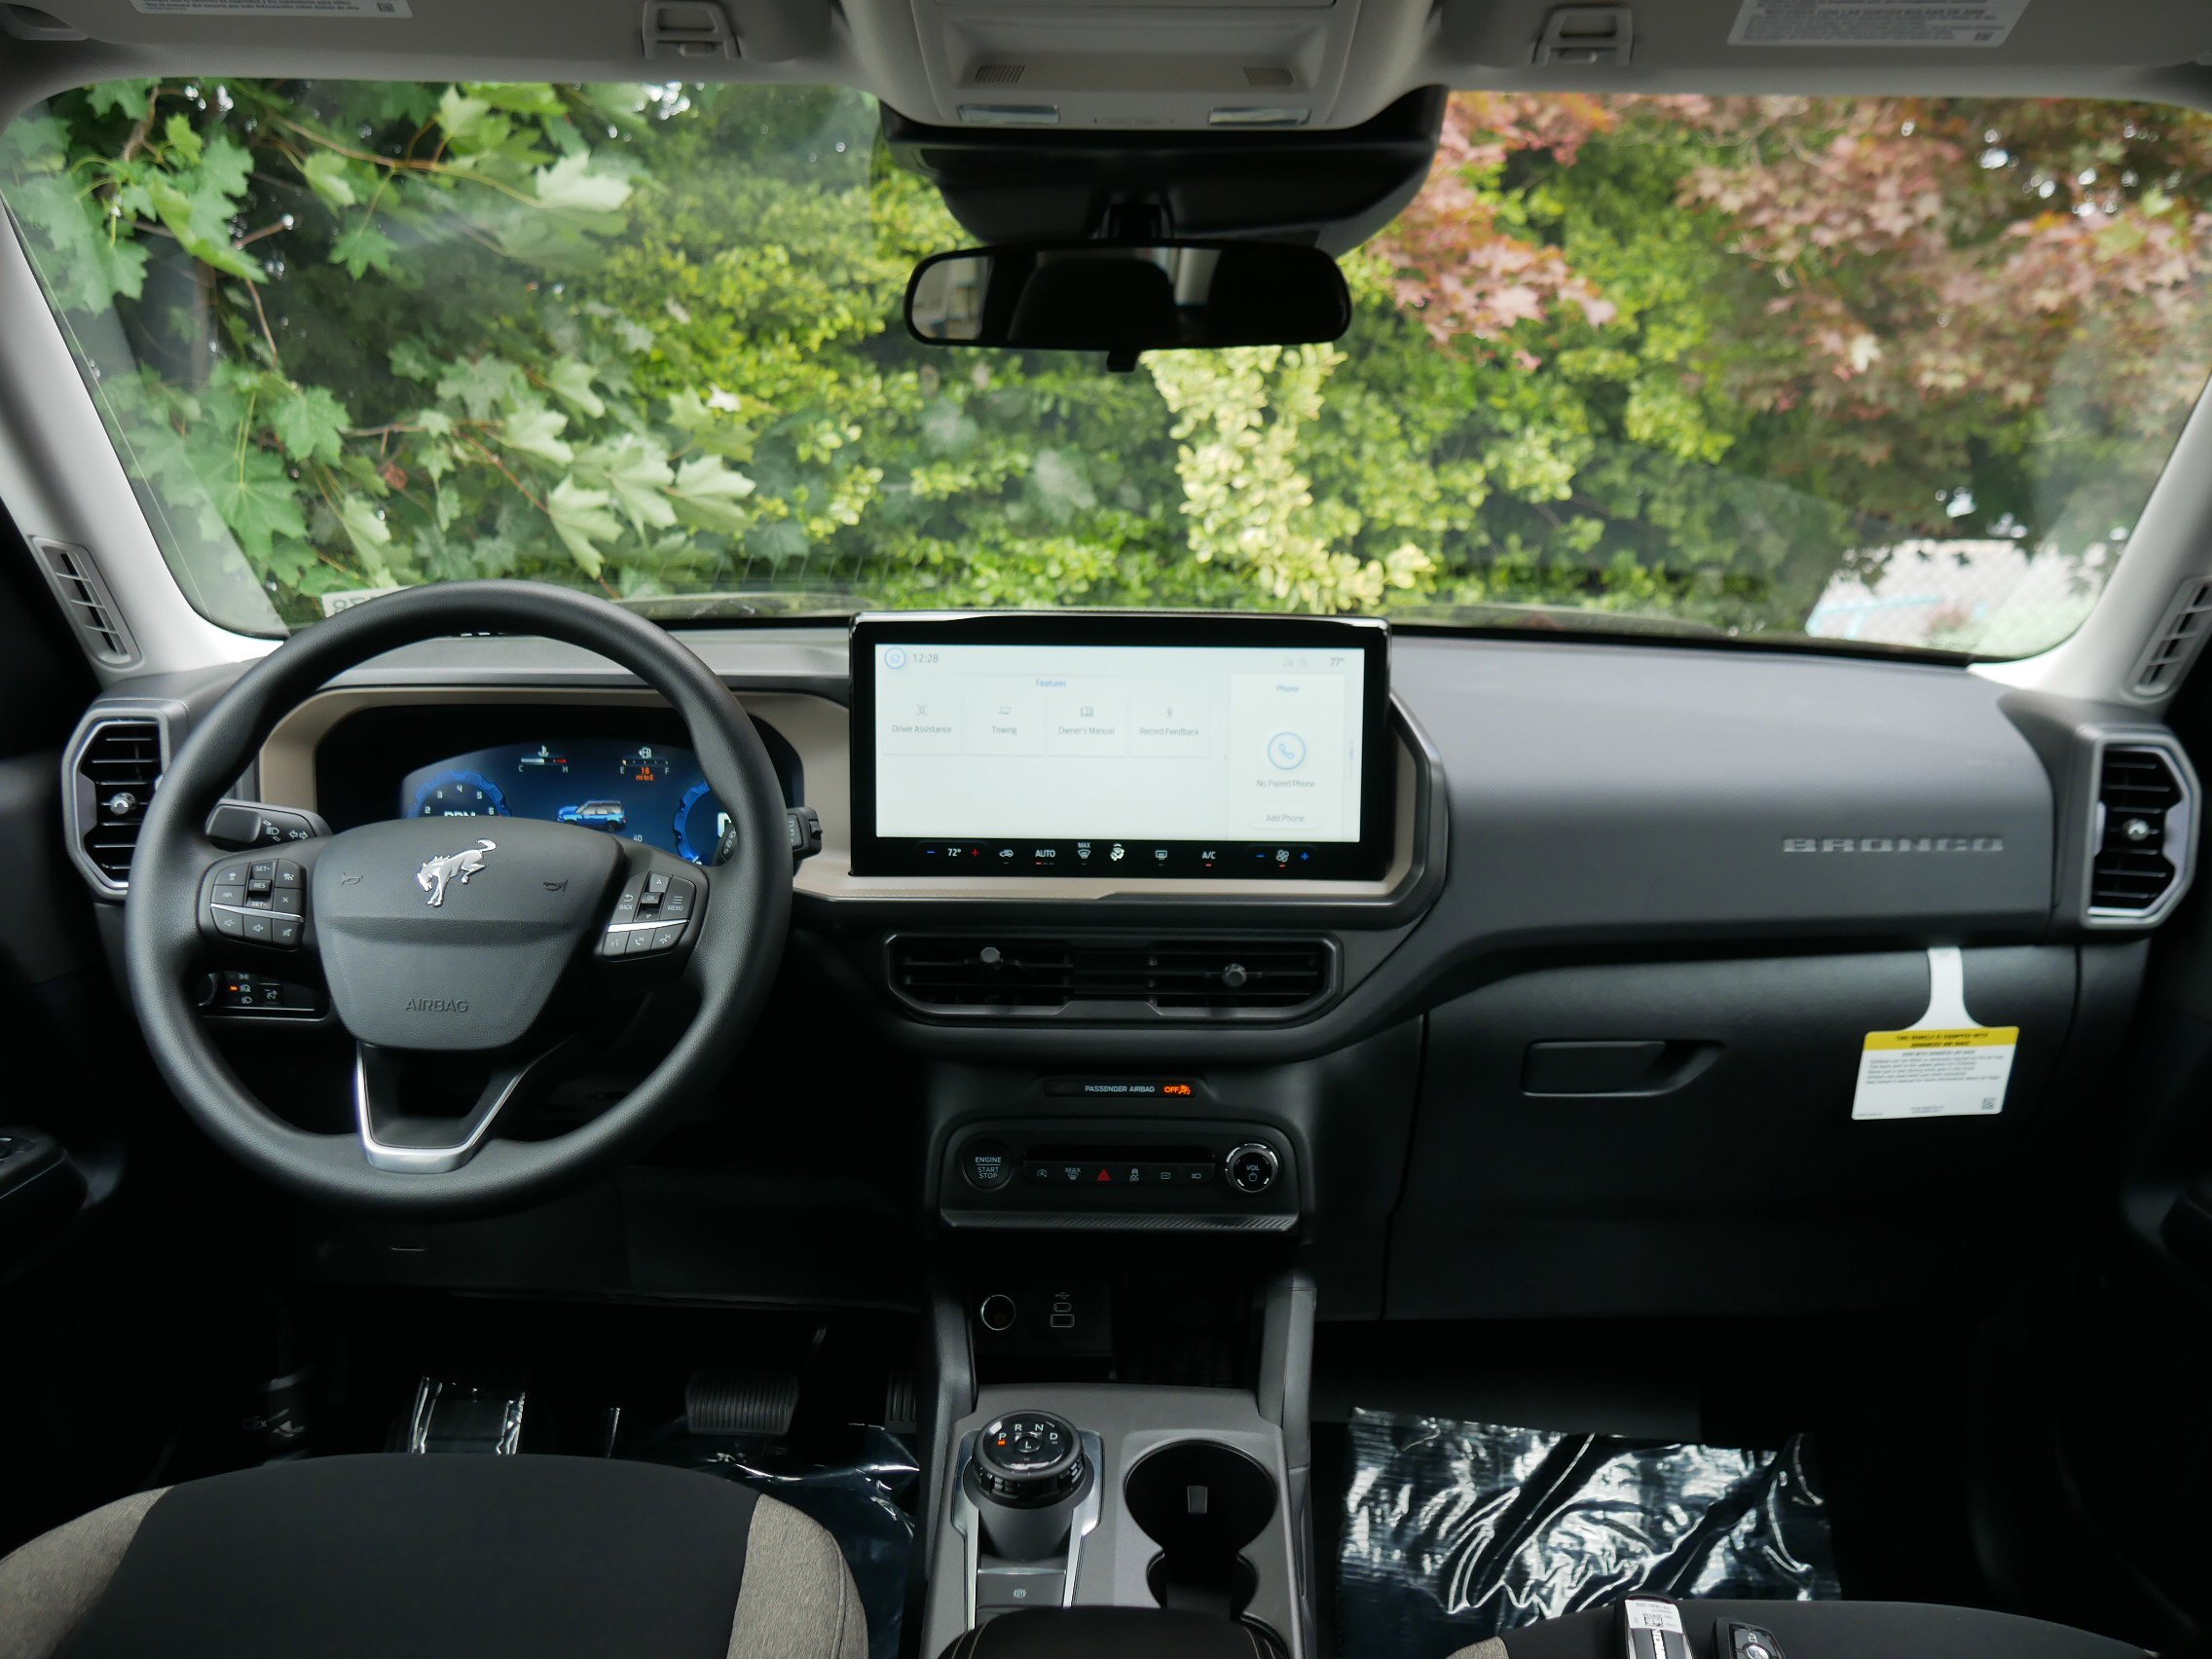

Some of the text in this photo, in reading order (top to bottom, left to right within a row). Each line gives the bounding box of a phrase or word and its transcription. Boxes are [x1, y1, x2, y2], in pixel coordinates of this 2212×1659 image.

[913, 653, 939, 663] 12:28
[1036, 679, 1067, 687] Features
[1275, 683, 1300, 693] Phone
[892, 724, 952, 733] Driver Assistance
[991, 725, 1018, 736] Towing
[1057, 726, 1116, 735] Owner's Manual
[1139, 726, 1199, 736] Record Feedback
[641, 766, 650, 775] 18
[1257, 779, 1315, 788] No Paired Phone
[477, 791, 483, 799] 5
[489, 806, 495, 816] 6
[1266, 814, 1306, 823] Add Phone
[1783, 838, 2004, 853] BRONCO
[947, 848, 962, 857] 72°
[1035, 849, 1055, 858] AUTO
[405, 998, 469, 1013] AIRBAG
[1085, 1085, 1180, 1094] PASSENGER AIRBAG OFF
